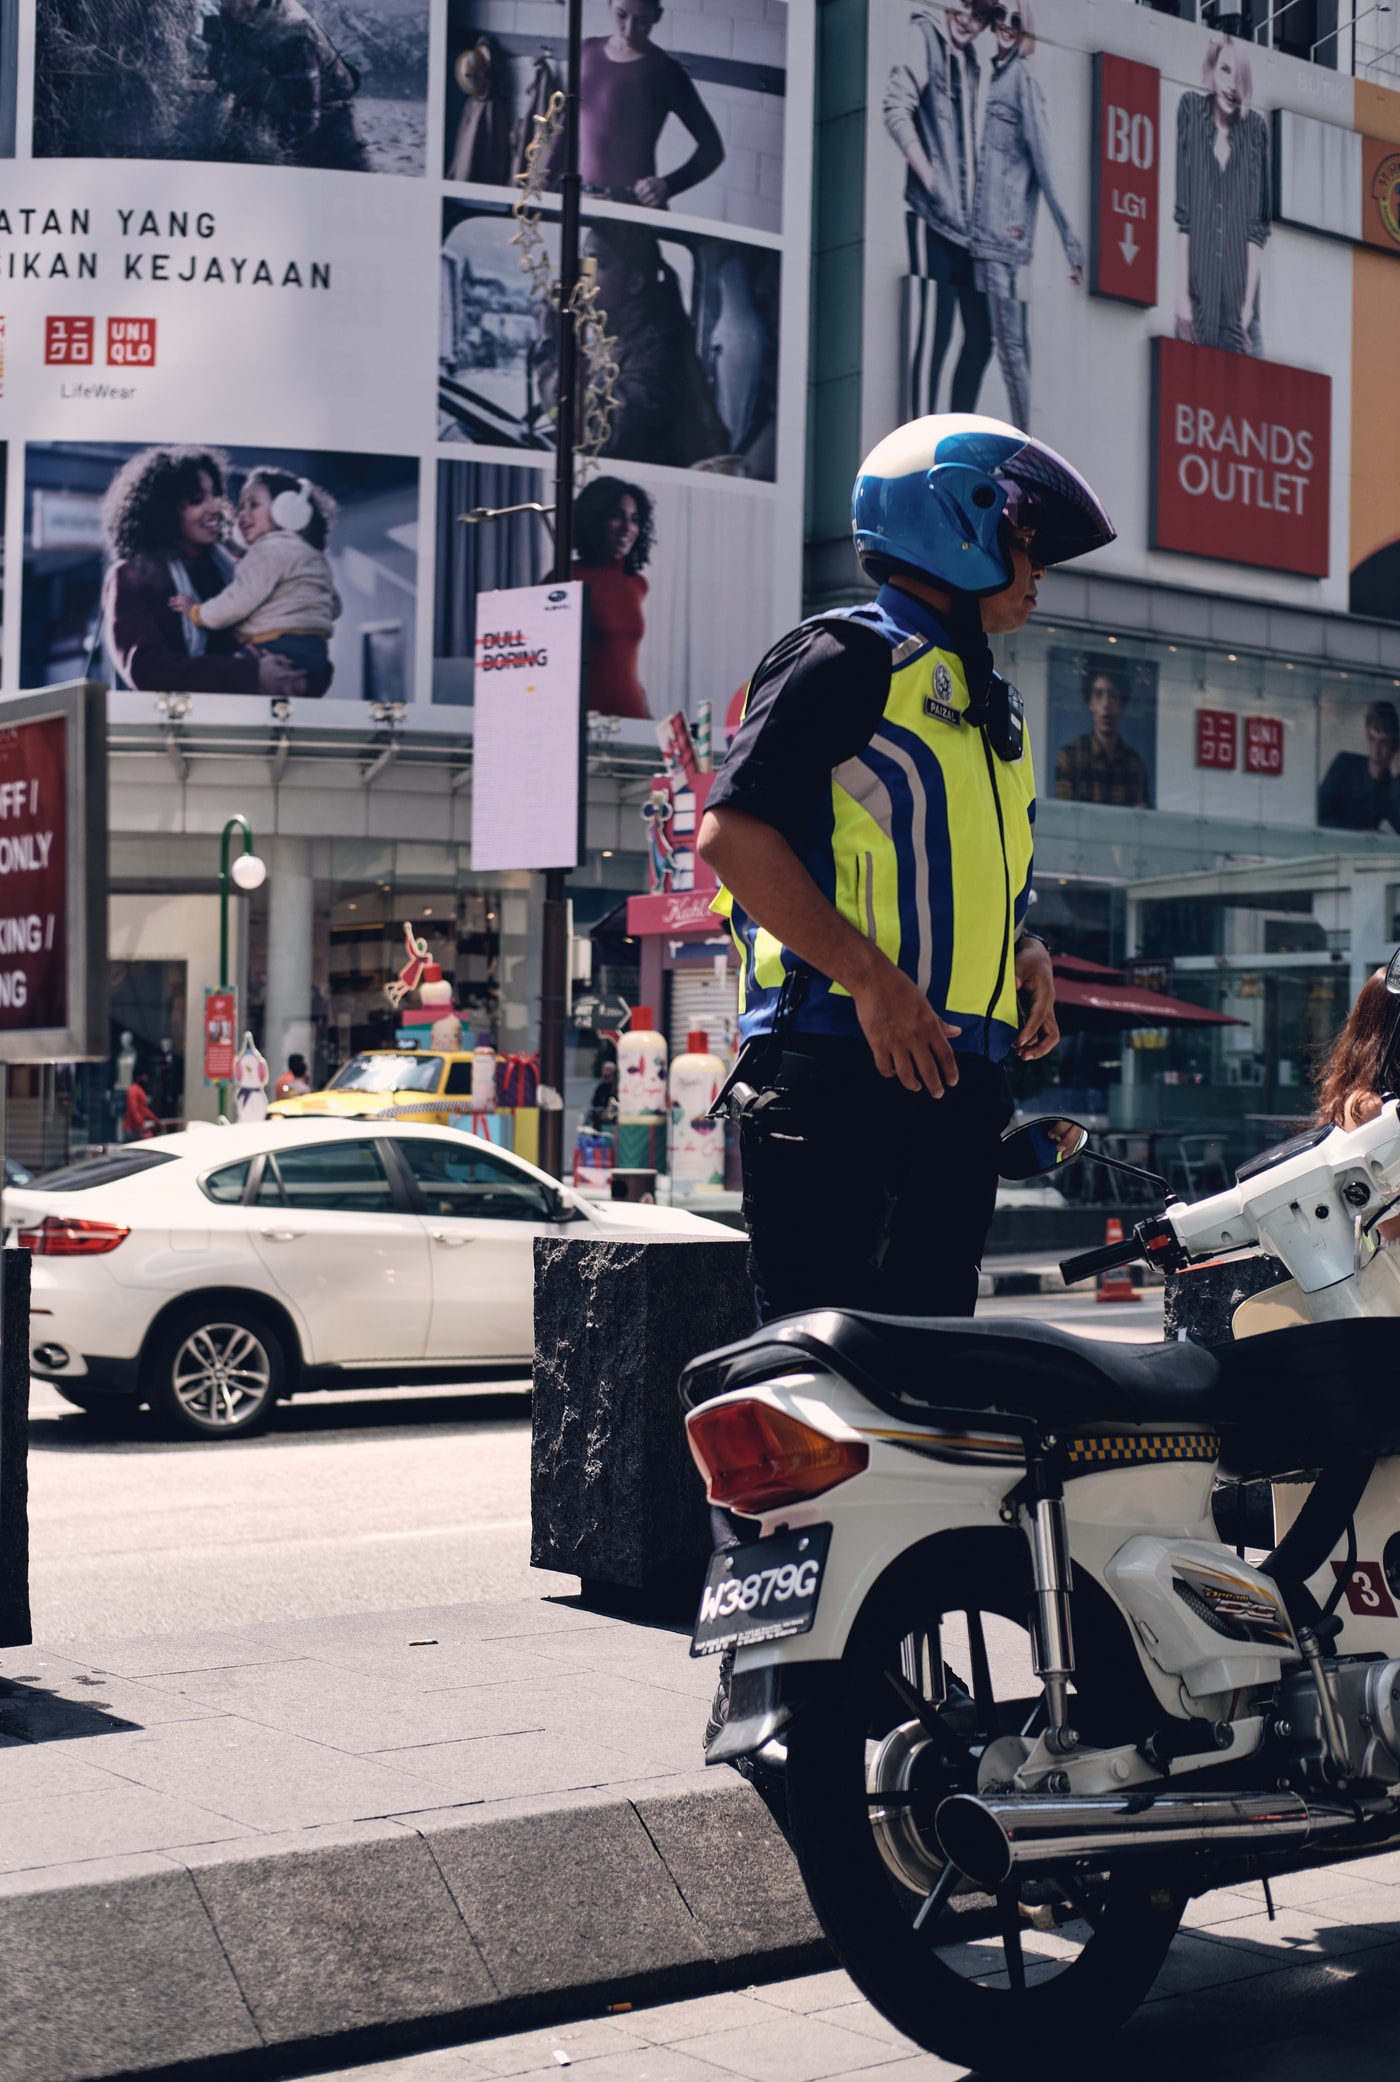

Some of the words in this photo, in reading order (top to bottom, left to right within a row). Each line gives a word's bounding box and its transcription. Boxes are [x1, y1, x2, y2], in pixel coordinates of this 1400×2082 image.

[1107, 104, 1154, 170] BO
[117, 209, 215, 238] YANG
[0, 252, 97, 279] IKAN
[125, 253, 331, 289] KEJAYAAN
[60, 383, 137, 399] LifeWear
[1176, 403, 1313, 471] BRANDS
[1178, 453, 1310, 516] OUTLET
[483, 630, 526, 650] DULL
[482, 648, 548, 672] BORING
[930, 701, 957, 722] PAIZAL
[0, 831, 53, 874] ONLY
[700, 1560, 819, 1623] W3879G
[1353, 1571, 1380, 1607] 3
